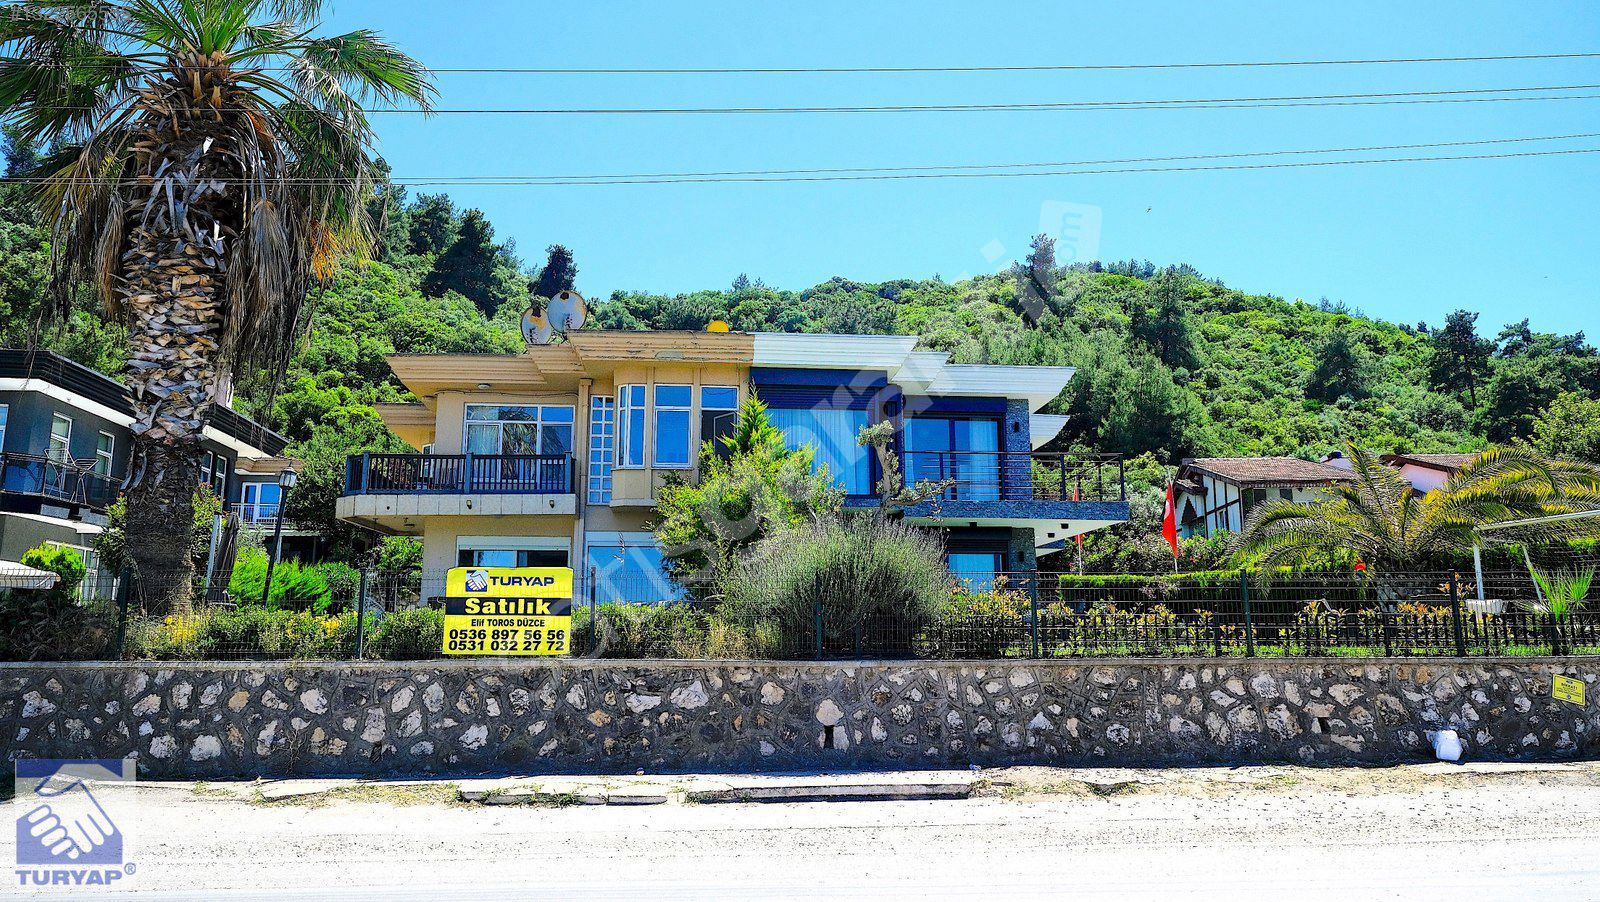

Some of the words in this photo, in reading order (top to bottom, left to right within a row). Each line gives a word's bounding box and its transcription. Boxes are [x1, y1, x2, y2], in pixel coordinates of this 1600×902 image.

[489, 576, 555, 586] TURYAP
[464, 597, 552, 615] Satılık
[471, 619, 485, 627] Elif
[487, 619, 515, 627] TOROS
[516, 618, 546, 627] DÜZCE
[449, 629, 487, 640] 0536
[491, 629, 519, 640] 897
[523, 630, 542, 640] 56
[546, 630, 565, 640] 56
[448, 640, 485, 651] 0531
[490, 640, 518, 651] 032
[522, 640, 541, 651] 27
[546, 640, 565, 651] 72
